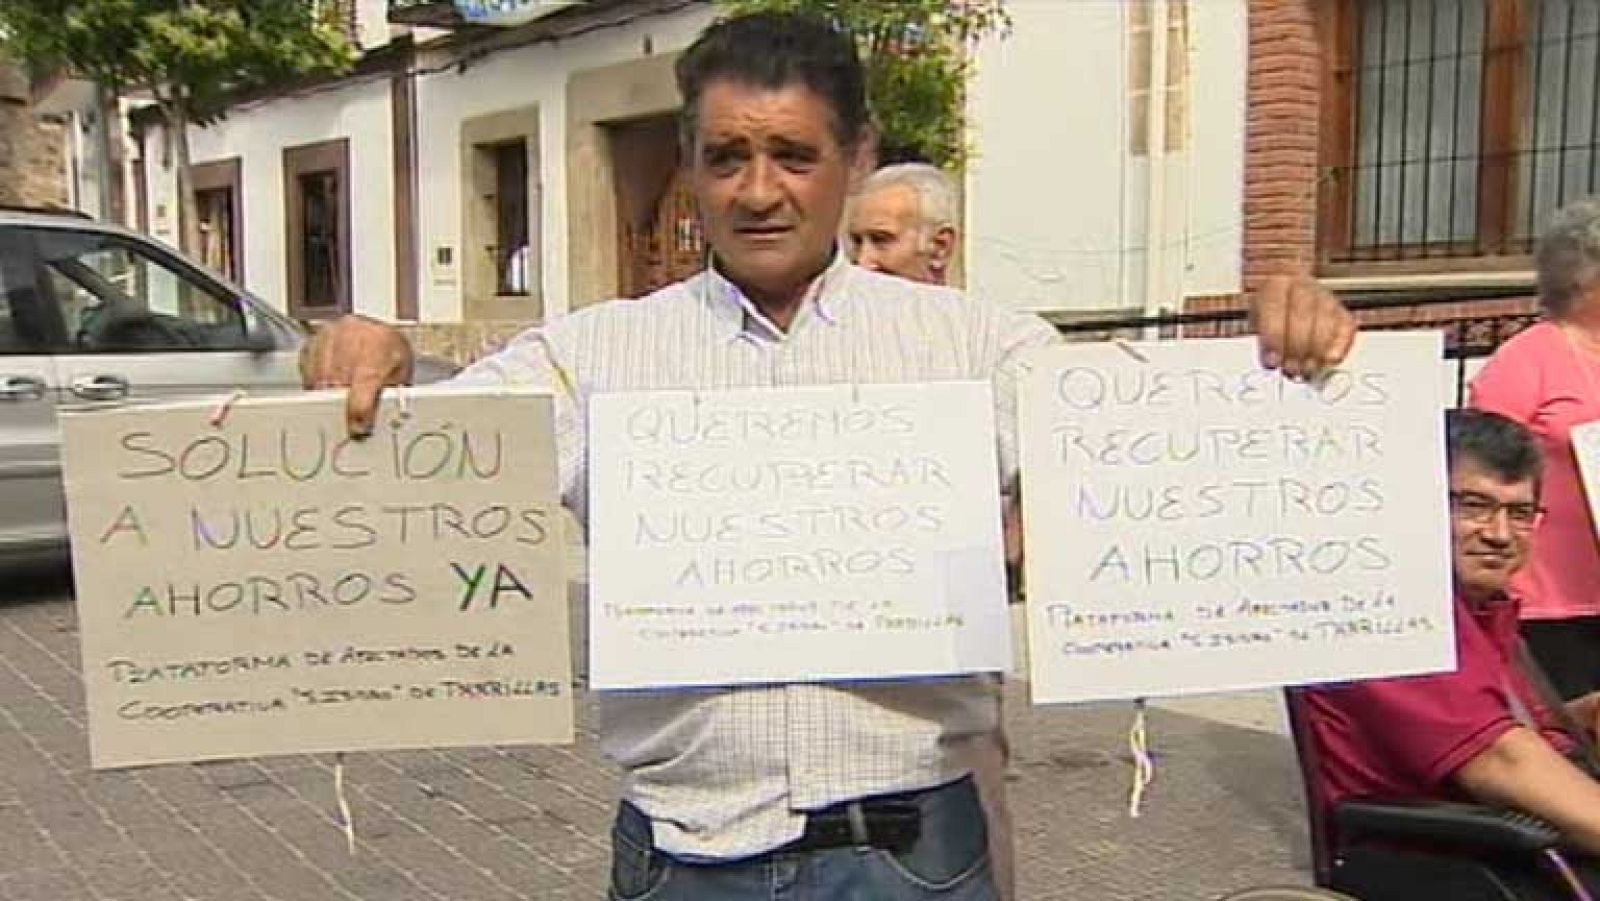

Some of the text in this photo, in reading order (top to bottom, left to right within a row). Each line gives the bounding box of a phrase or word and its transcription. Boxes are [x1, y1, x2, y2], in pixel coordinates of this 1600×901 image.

[626, 400, 916, 444] QUEREMOS
[1052, 425, 1384, 466] RECUPERAR
[625, 457, 953, 494] RECUPERAR
[1077, 477, 1386, 522] NUESTROS
[99, 503, 547, 551] A NUESTROS
[635, 505, 944, 545] NUESTROS
[676, 547, 916, 586] AHORROS
[1089, 536, 1392, 585] AHORROS
[124, 562, 534, 619] AHORROS YA
